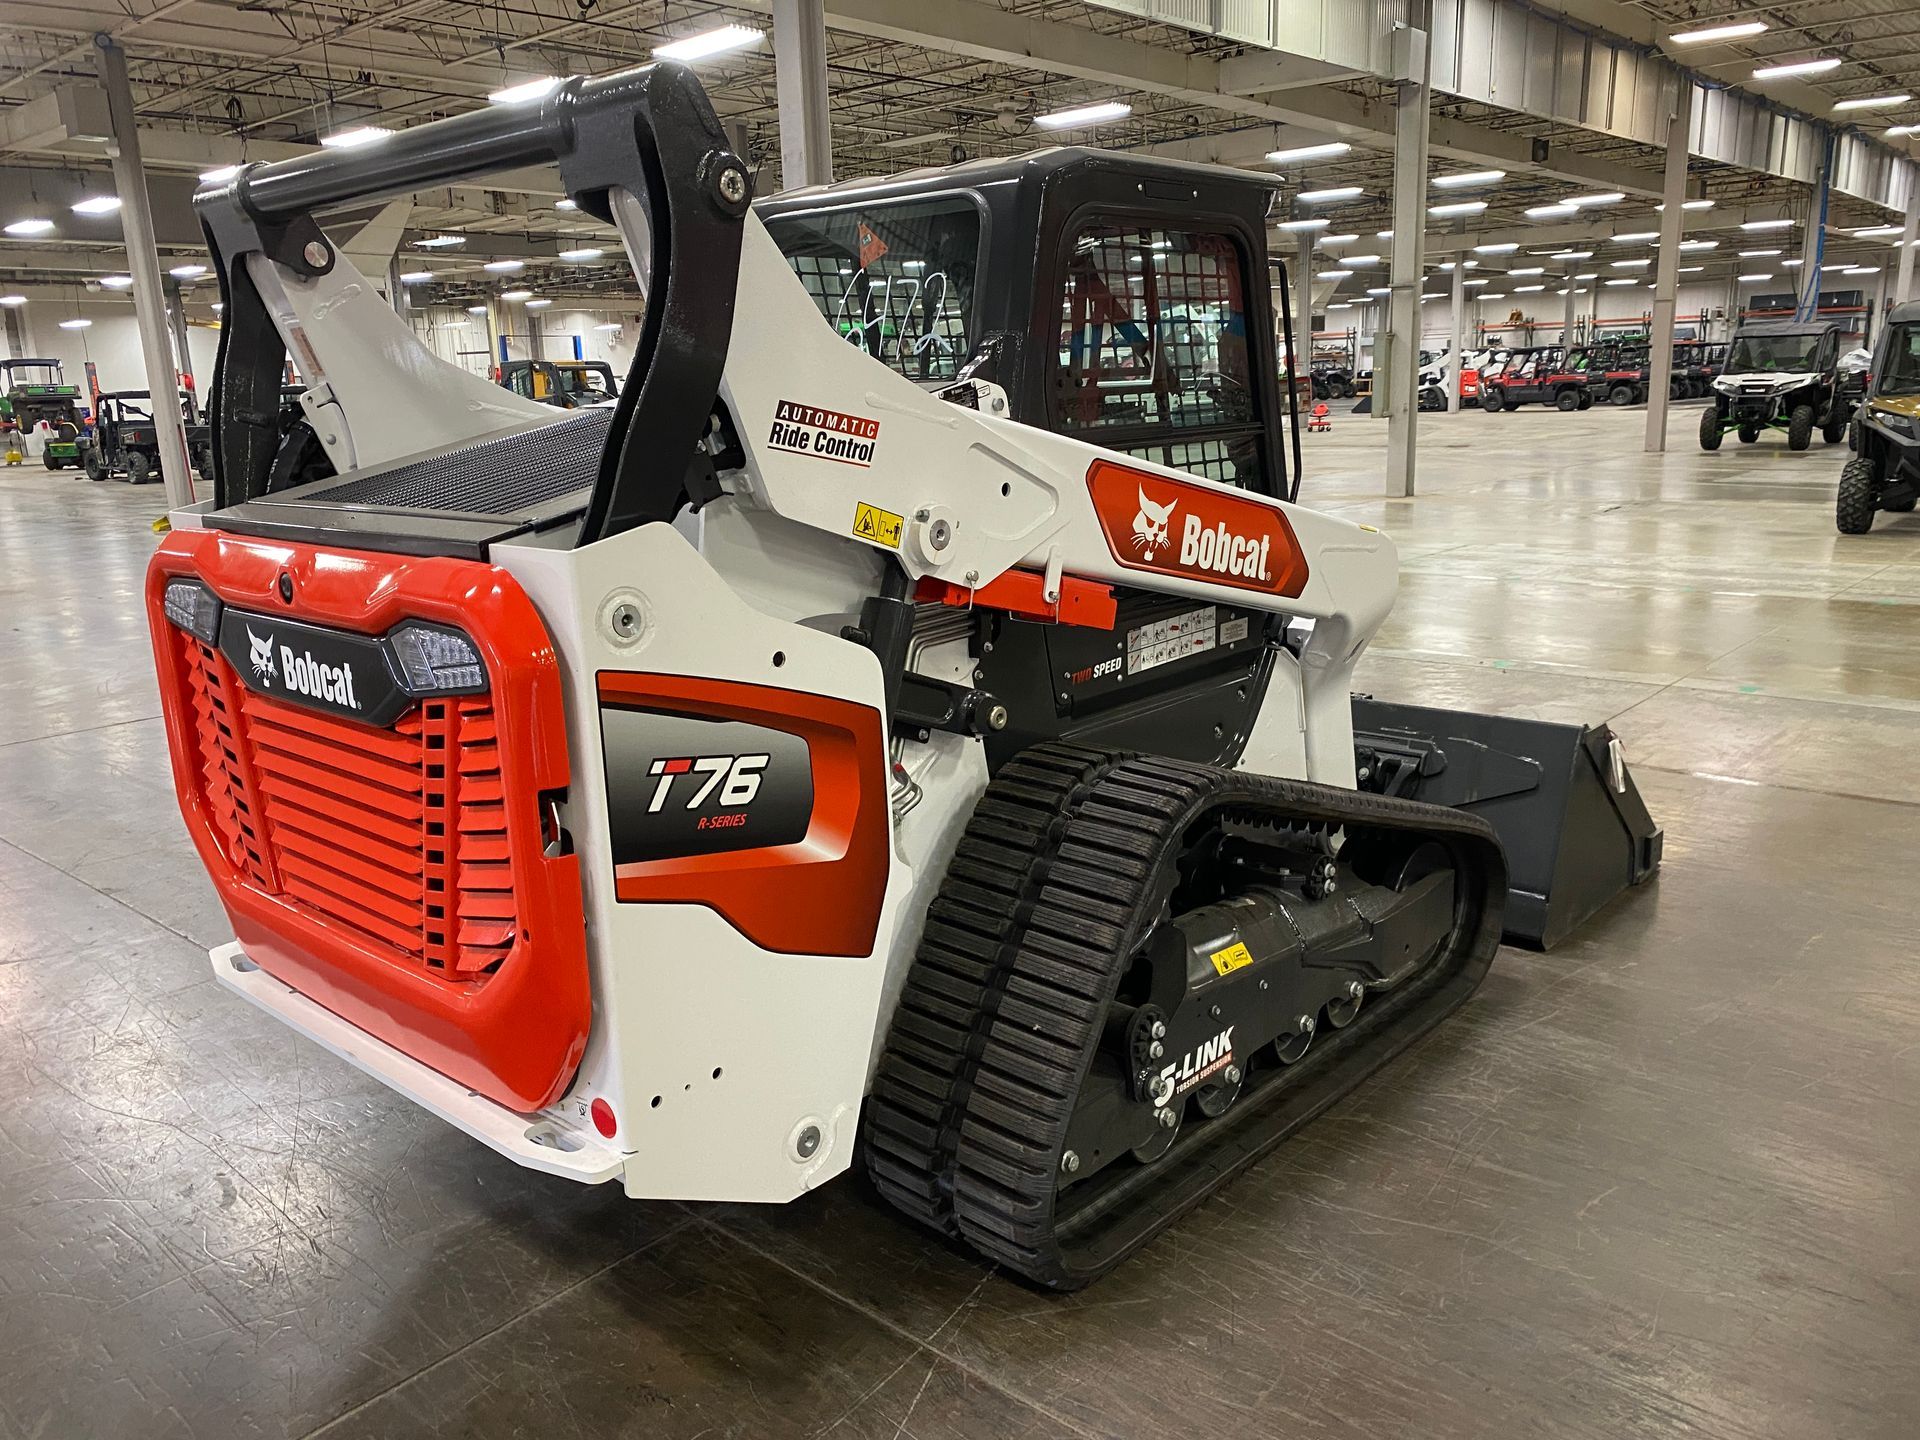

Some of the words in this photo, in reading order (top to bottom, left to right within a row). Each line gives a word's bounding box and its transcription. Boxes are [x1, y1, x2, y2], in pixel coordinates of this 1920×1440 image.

[780, 404, 875, 437] AUTOMATIC
[769, 421, 810, 449] Ride
[814, 431, 875, 462] Control
[1180, 513, 1270, 580] Bobcat
[280, 645, 356, 709] Bobcat
[1072, 667, 1092, 685] TWO
[1093, 657, 1122, 679] SPEED
[647, 755, 769, 812] T76
[697, 814, 747, 830] R-SERIES
[1154, 1025, 1234, 1107] 5-LINK
[1176, 1074, 1200, 1094] TORSION
[1200, 1055, 1232, 1080] SUSPENSION
